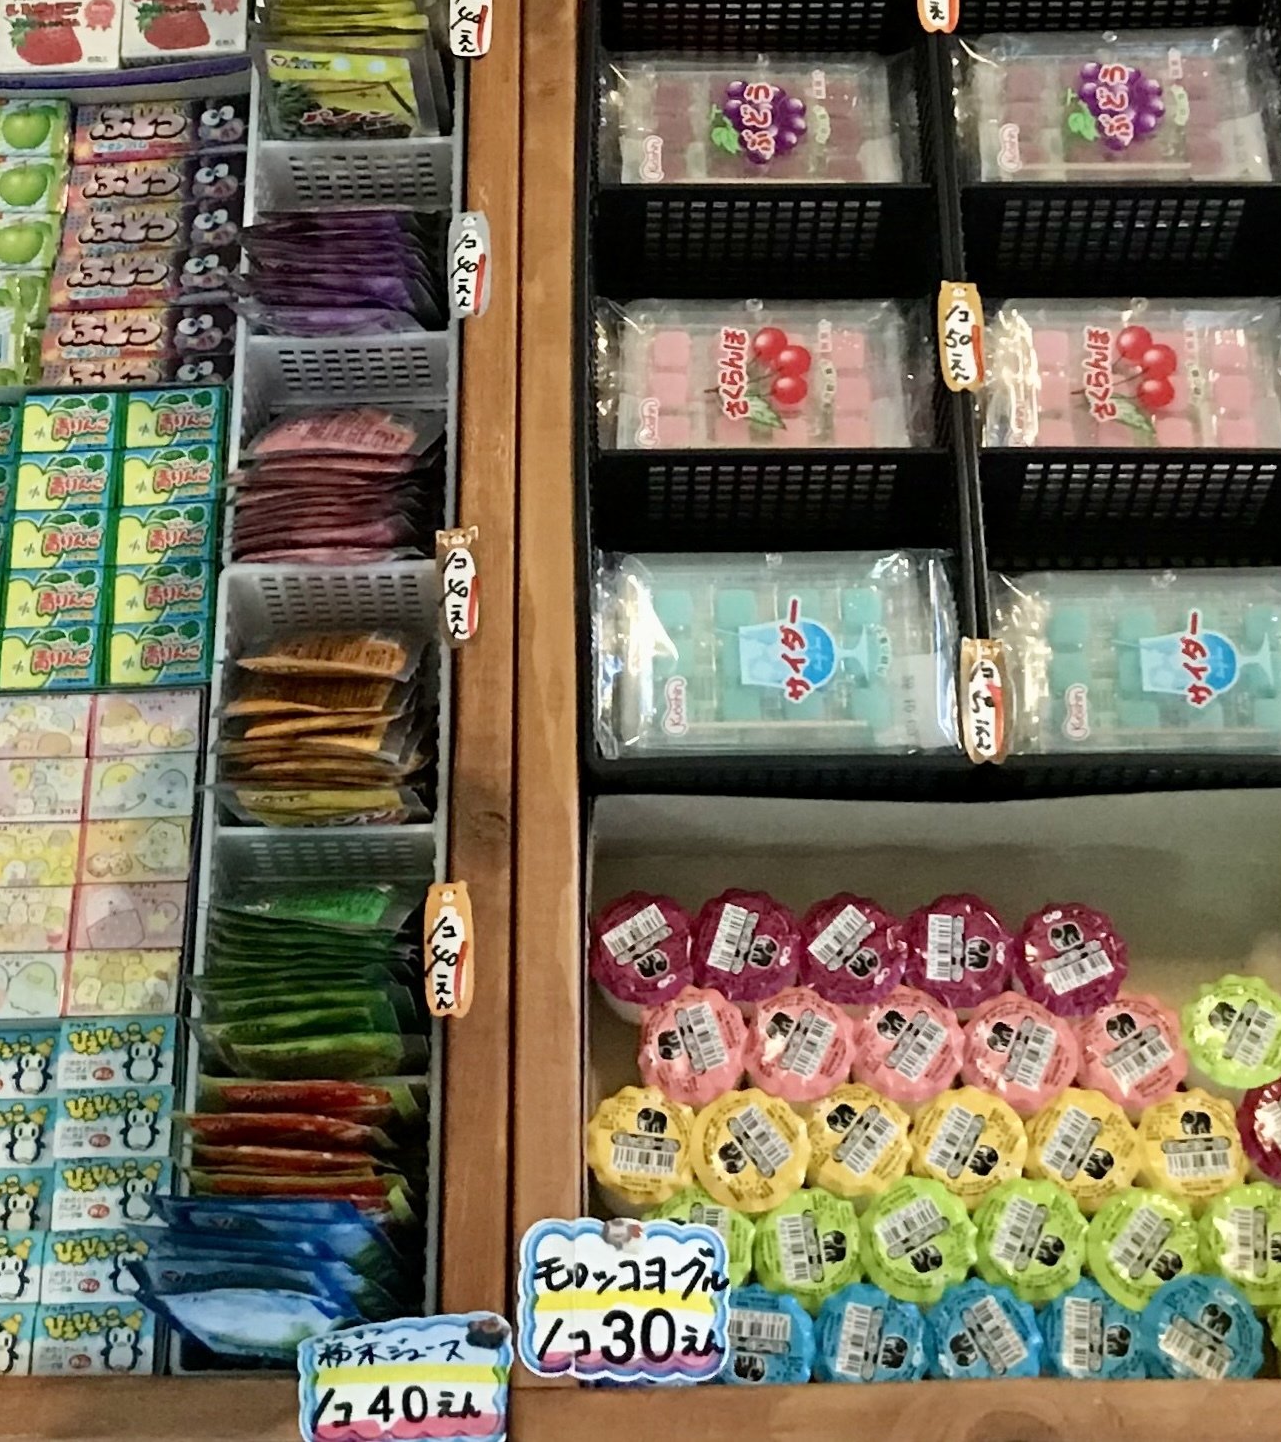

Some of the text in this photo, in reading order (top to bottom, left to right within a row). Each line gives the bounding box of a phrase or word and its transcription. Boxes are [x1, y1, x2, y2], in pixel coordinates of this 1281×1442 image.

[742, 82, 775, 159] ぶどう
[1100, 62, 1134, 142] ぶどう
[721, 328, 749, 420] さくらんぼ
[1085, 327, 1114, 421] さくらんぼ
[785, 596, 811, 704] サイダー
[1182, 609, 1211, 707] サイダー
